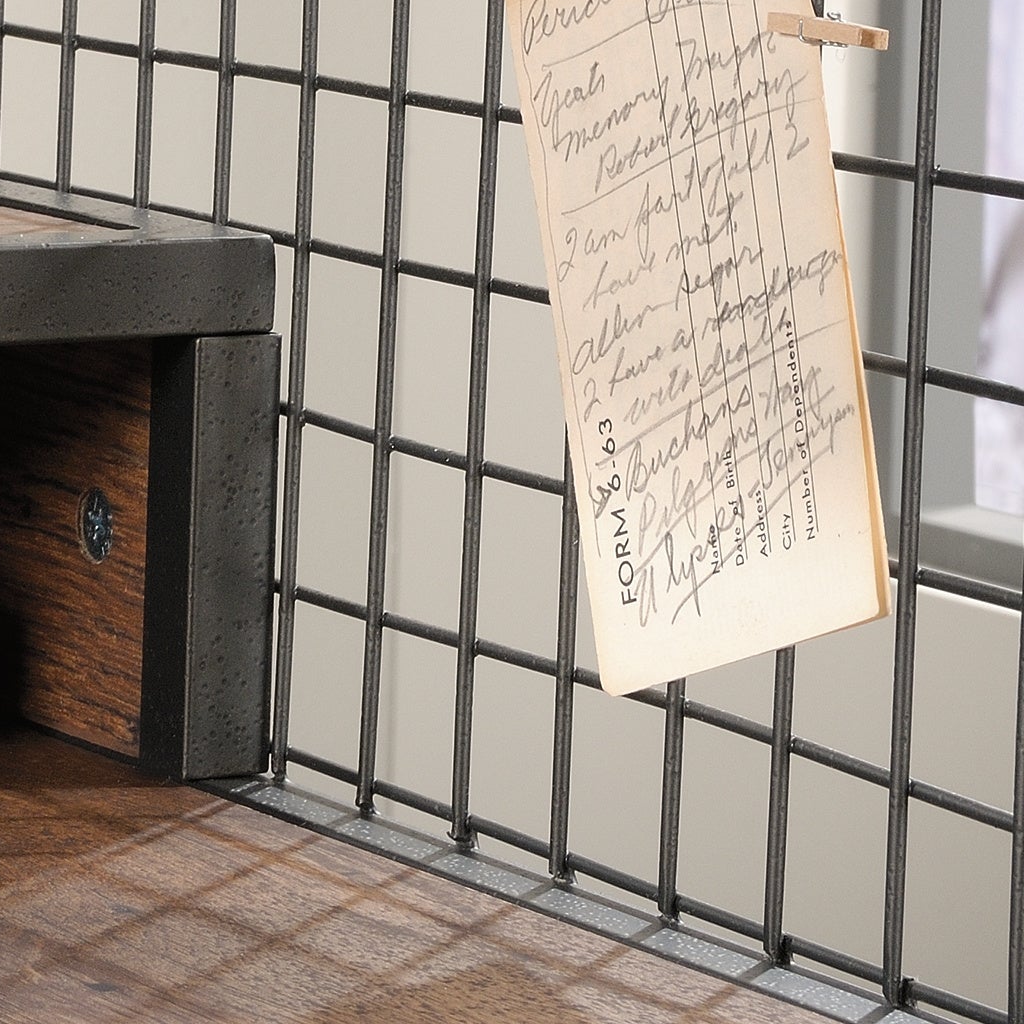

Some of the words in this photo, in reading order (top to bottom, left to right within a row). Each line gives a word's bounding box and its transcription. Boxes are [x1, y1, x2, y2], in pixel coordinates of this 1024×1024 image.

[785, 319, 805, 433] Dependents
[723, 449, 736, 489] Birth
[795, 440, 807, 460] of
[754, 489, 770, 558] Address
[781, 512, 794, 552] City
[799, 469, 817, 541] Number
[610, 507, 637, 605] FORM
[735, 527, 745, 567] Date
